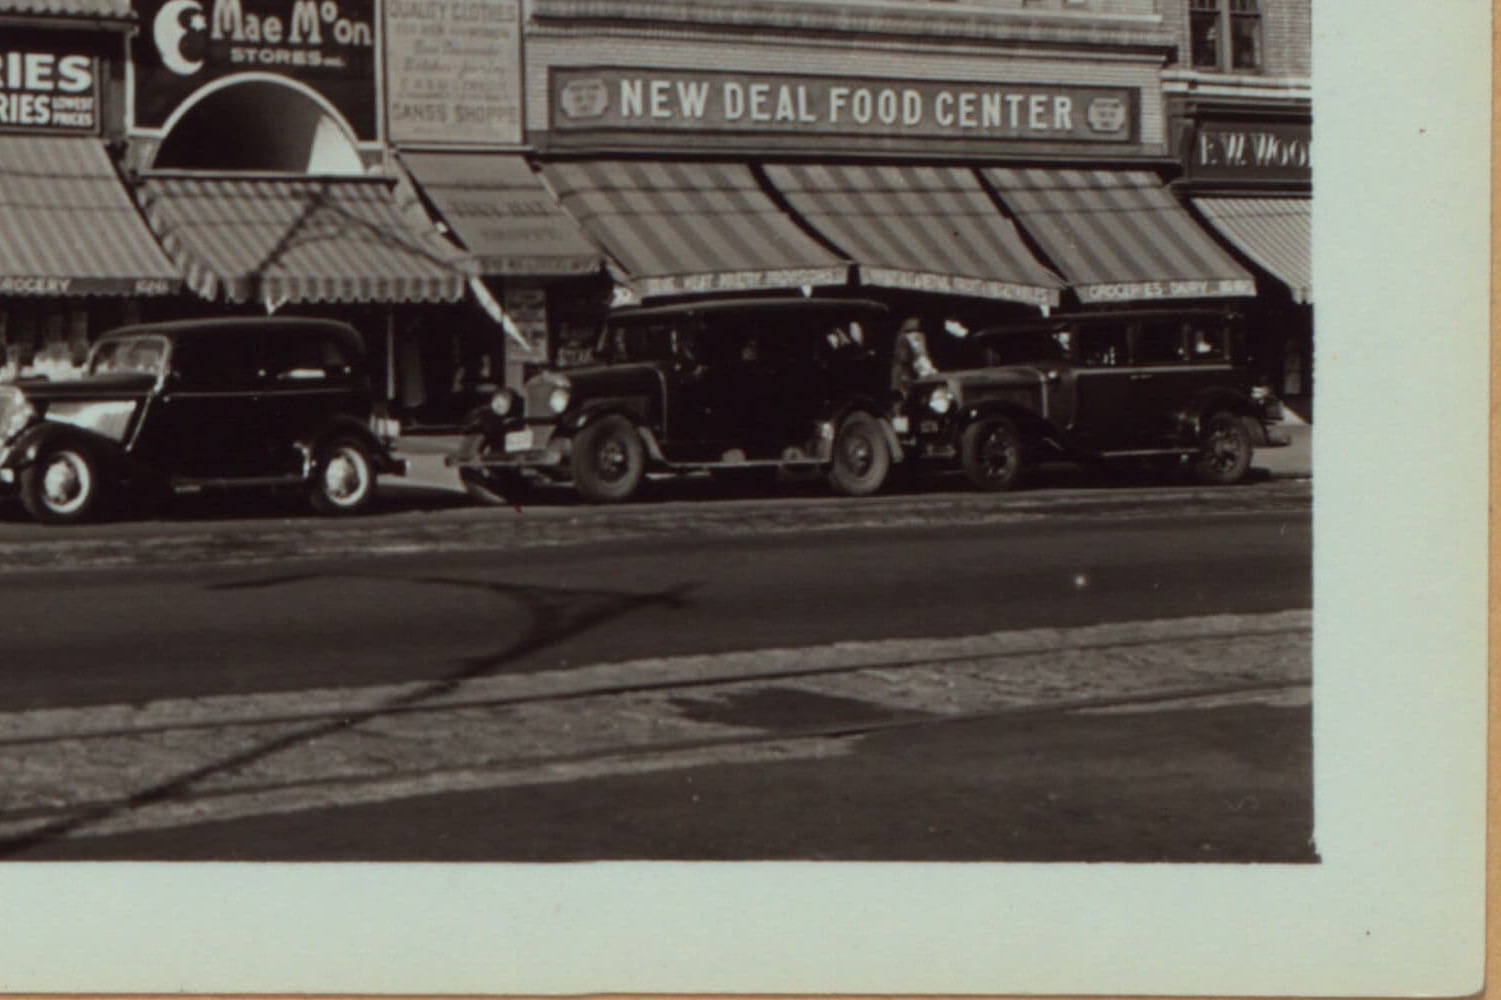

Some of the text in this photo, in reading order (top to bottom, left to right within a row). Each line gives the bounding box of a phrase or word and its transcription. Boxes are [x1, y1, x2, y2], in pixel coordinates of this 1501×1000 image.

[288, 0, 374, 46] Moon
[230, 47, 322, 67] STORES
[620, 78, 709, 119] NEW
[723, 82, 816, 123] DEAL
[828, 86, 923, 126] FOOD
[934, 90, 1073, 130] CENTER
